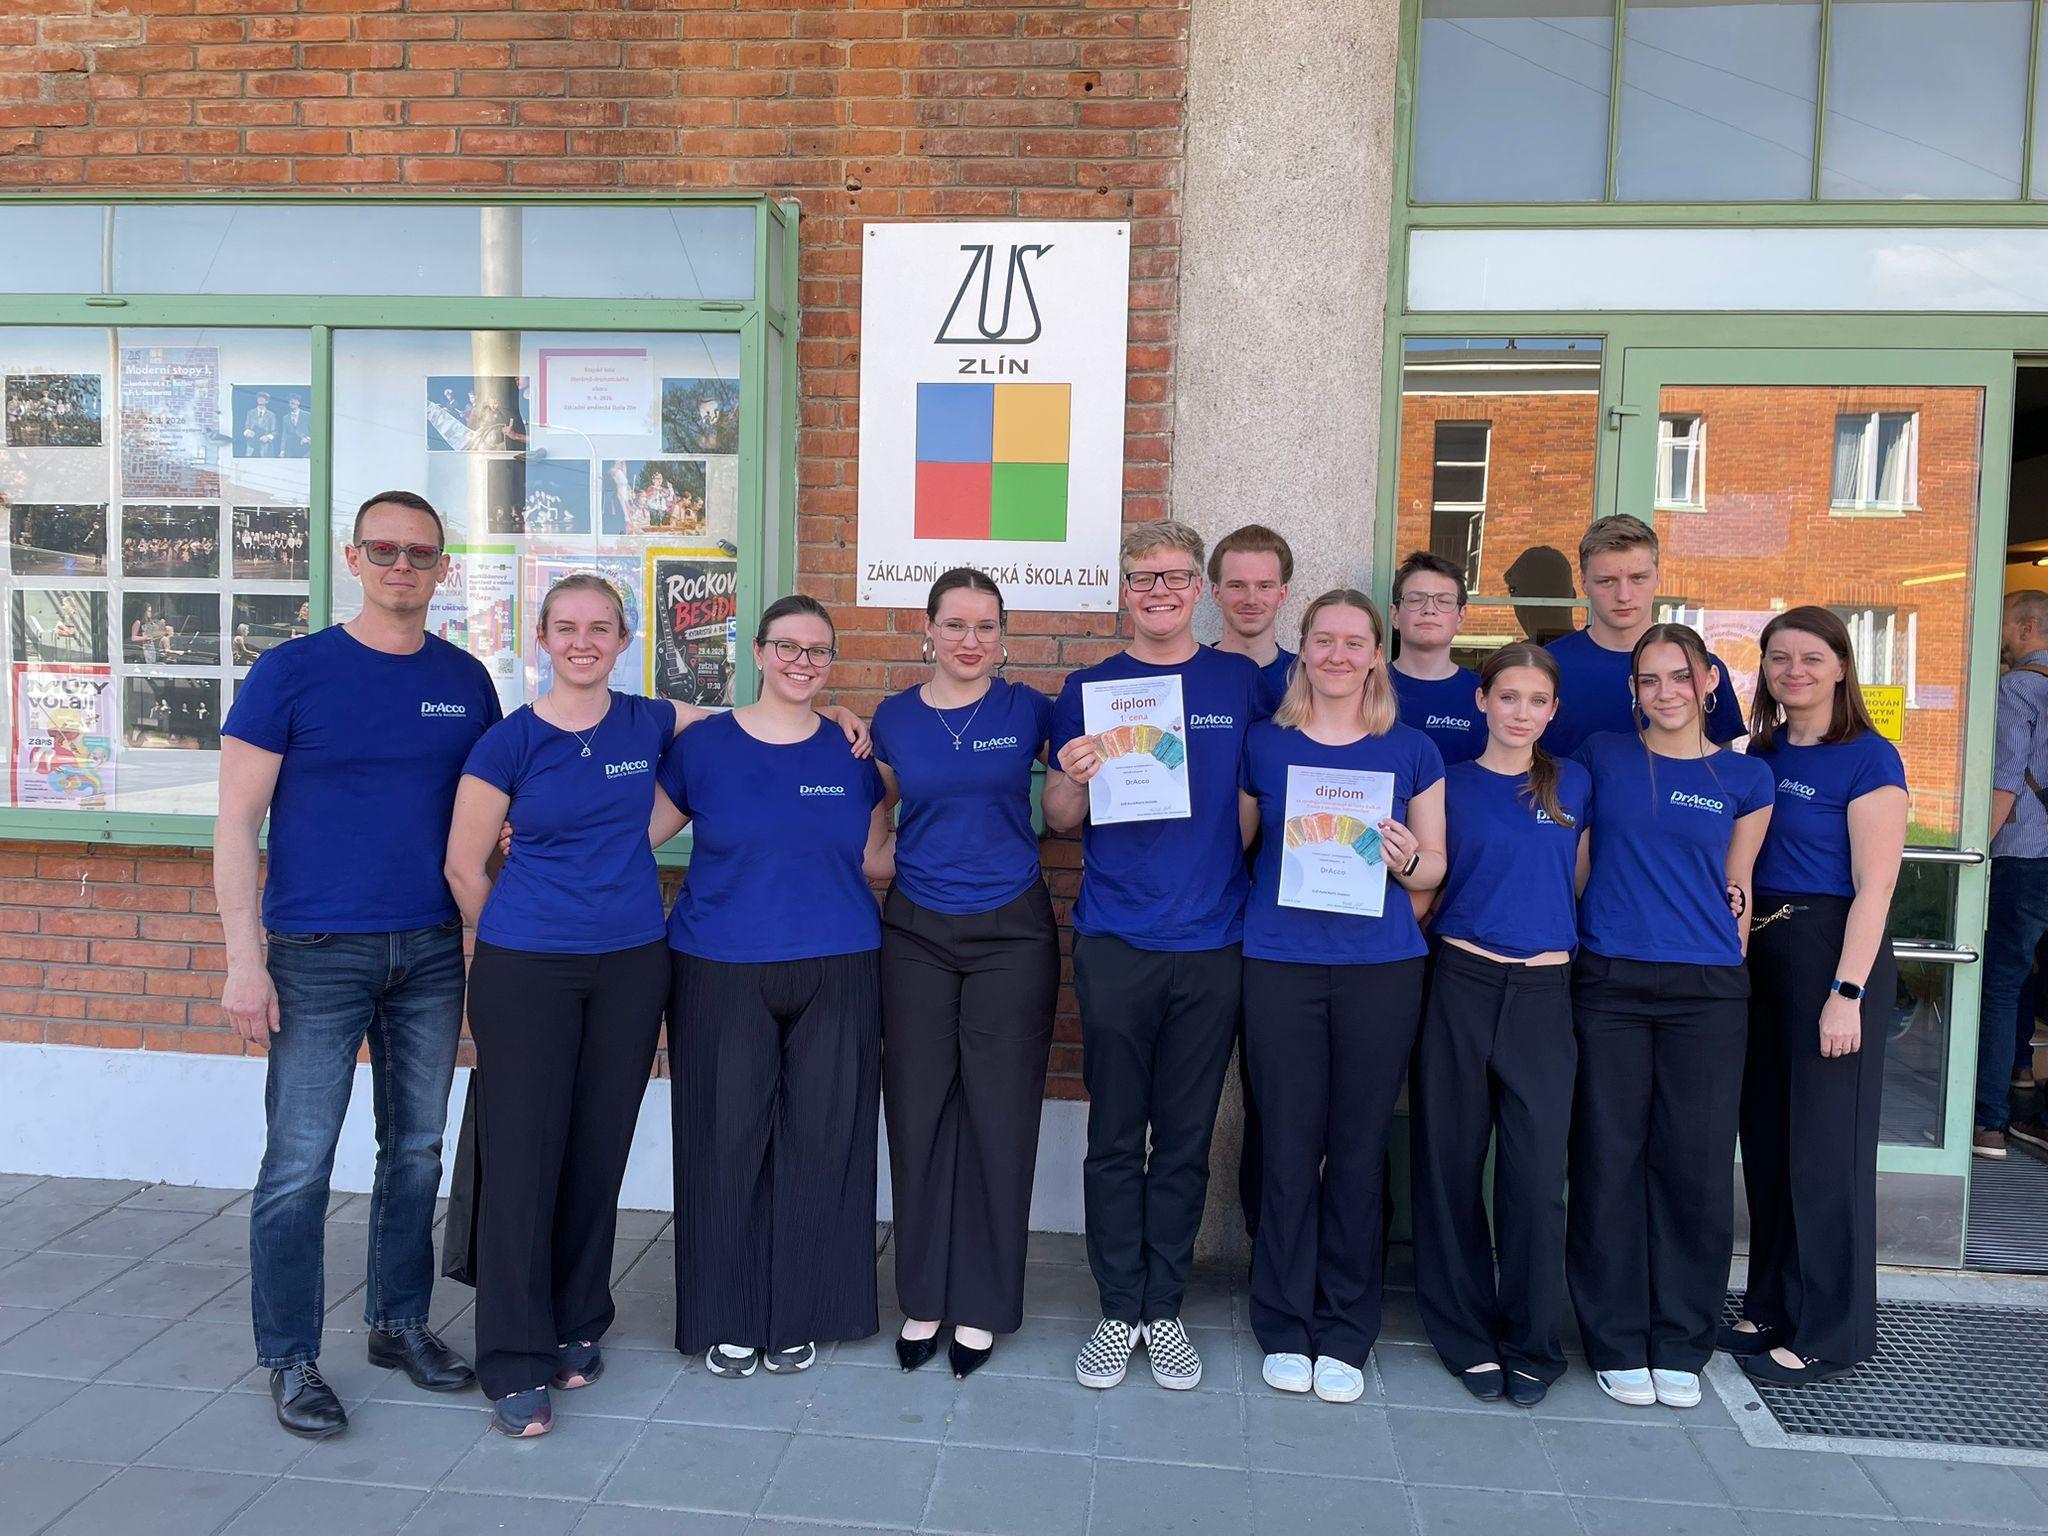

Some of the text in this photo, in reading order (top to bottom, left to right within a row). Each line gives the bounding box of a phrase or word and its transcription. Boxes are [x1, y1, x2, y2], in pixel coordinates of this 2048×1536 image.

[126, 364, 170, 374] Moderní
[172, 365, 201, 377] stopy
[958, 354, 1029, 374] ZLÍN
[867, 560, 937, 582] ZÁKLADNÍ
[1025, 563, 1073, 585] ŠKOLA
[1078, 564, 1109, 586] ZLÍN
[665, 570, 737, 609] ROCKOV
[421, 701, 466, 713] DrAcco
[1111, 697, 1156, 712] diplom
[1866, 698, 1900, 706] ROVÁN
[1190, 714, 1233, 725] DrAcco
[1426, 715, 1471, 728] DrAcco
[973, 736, 1017, 749] DrAcco
[605, 760, 648, 775] DrAcco
[800, 785, 844, 793] DrAcco
[1315, 785, 1364, 800] diplom
[1779, 778, 1816, 796] DrAcco
[1670, 790, 1724, 810] DrAcco
[1320, 866, 1346, 876] DrAcco
